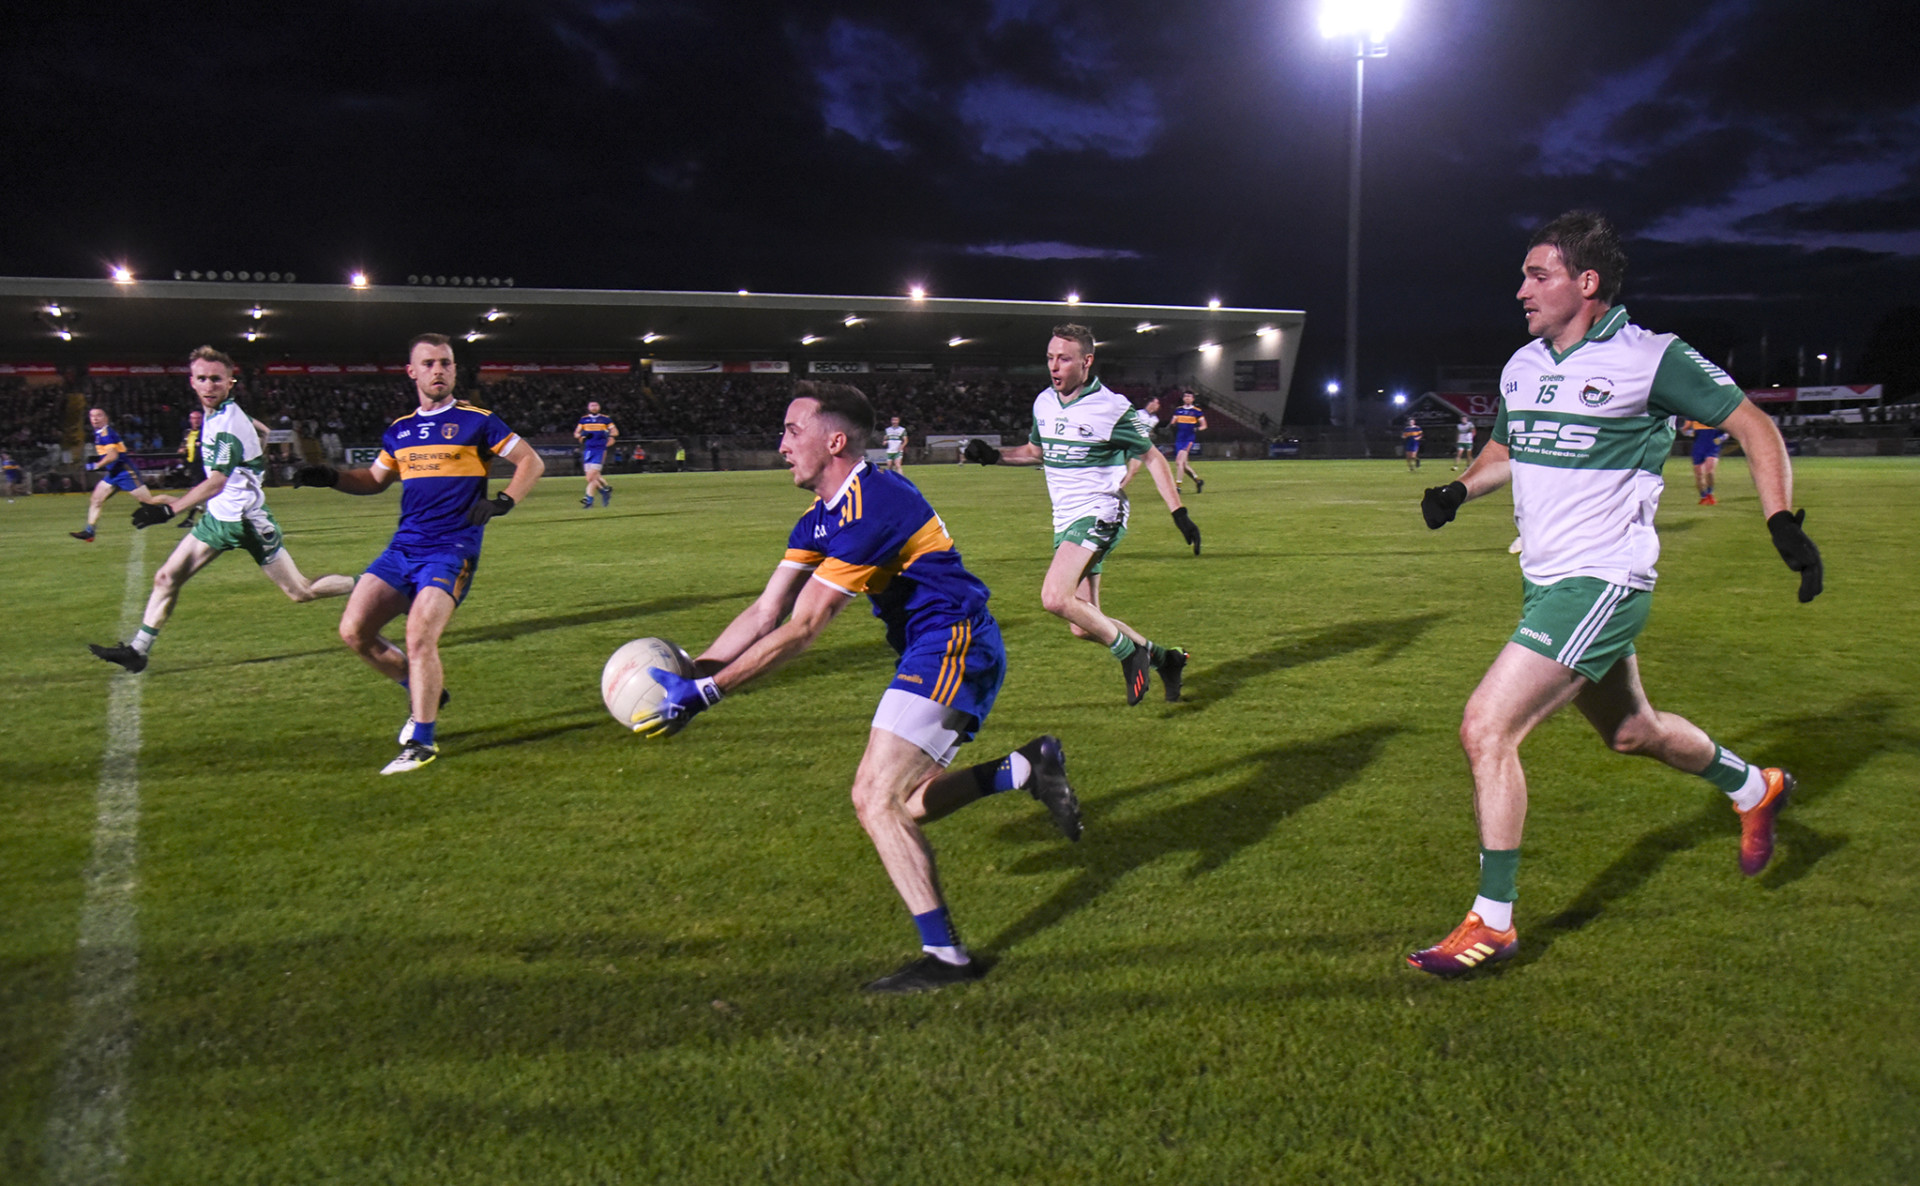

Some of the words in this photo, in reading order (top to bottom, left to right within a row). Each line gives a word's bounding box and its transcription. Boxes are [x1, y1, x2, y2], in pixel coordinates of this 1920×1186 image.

[1535, 384, 1558, 404] 15
[418, 427, 430, 439] 5
[1055, 423, 1065, 435] 12
[1520, 627, 1552, 646] oneills
